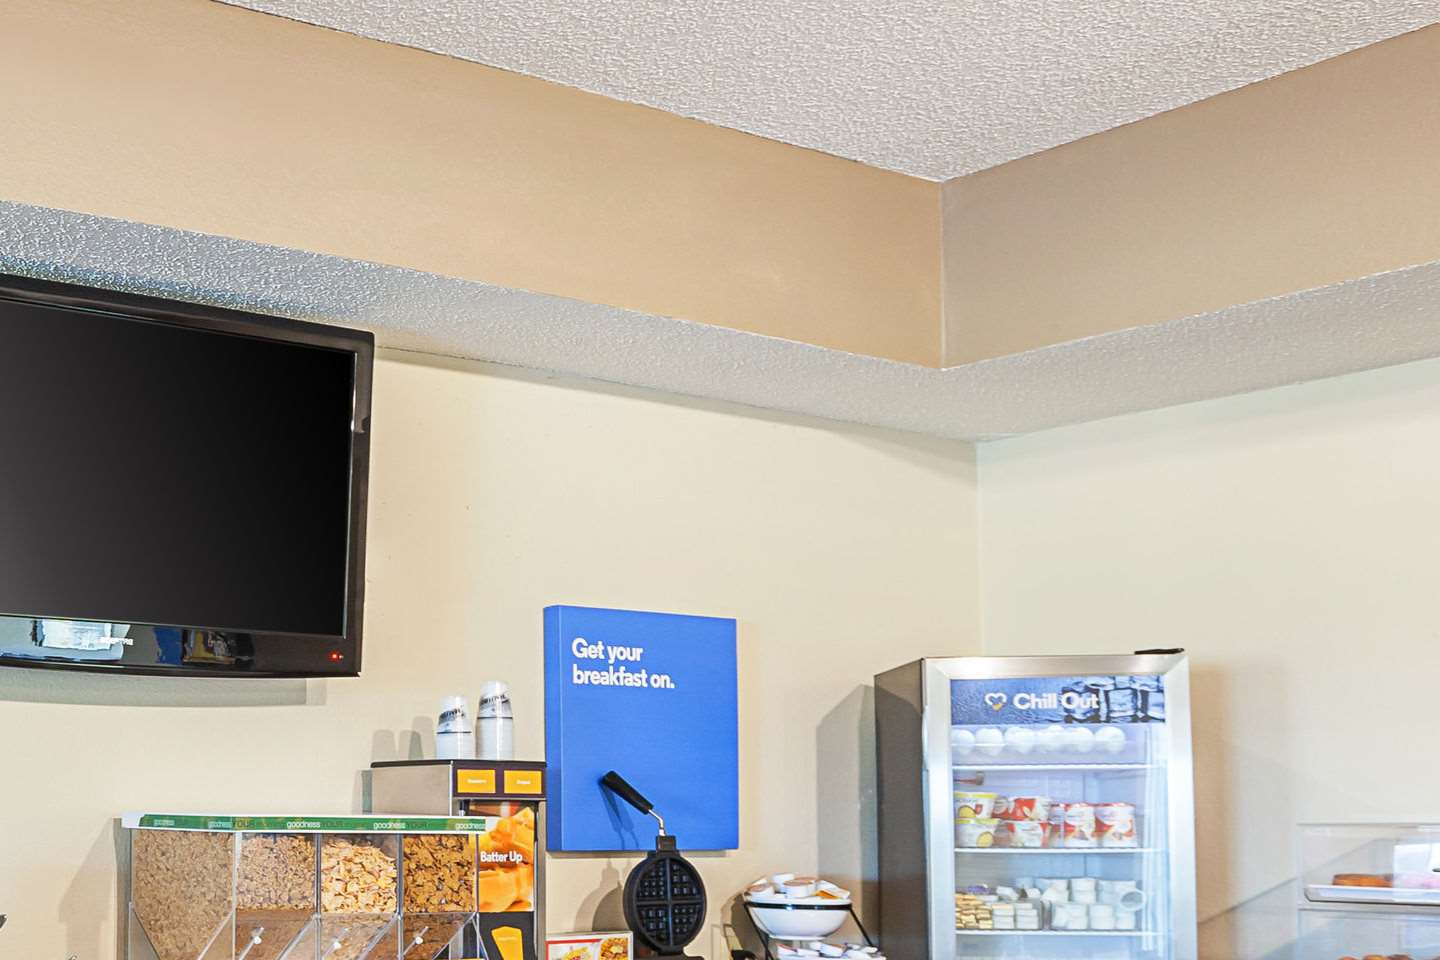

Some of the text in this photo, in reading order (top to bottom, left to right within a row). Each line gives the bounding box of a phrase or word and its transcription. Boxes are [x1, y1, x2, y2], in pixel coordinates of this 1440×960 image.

[572, 637, 644, 665] Get your
[572, 663, 675, 689] breakfast on.
[1012, 692, 1100, 710] Chill Out
[287, 820, 321, 831] goodness
[373, 821, 406, 831] goodness
[480, 850, 523, 865] Batter Up
